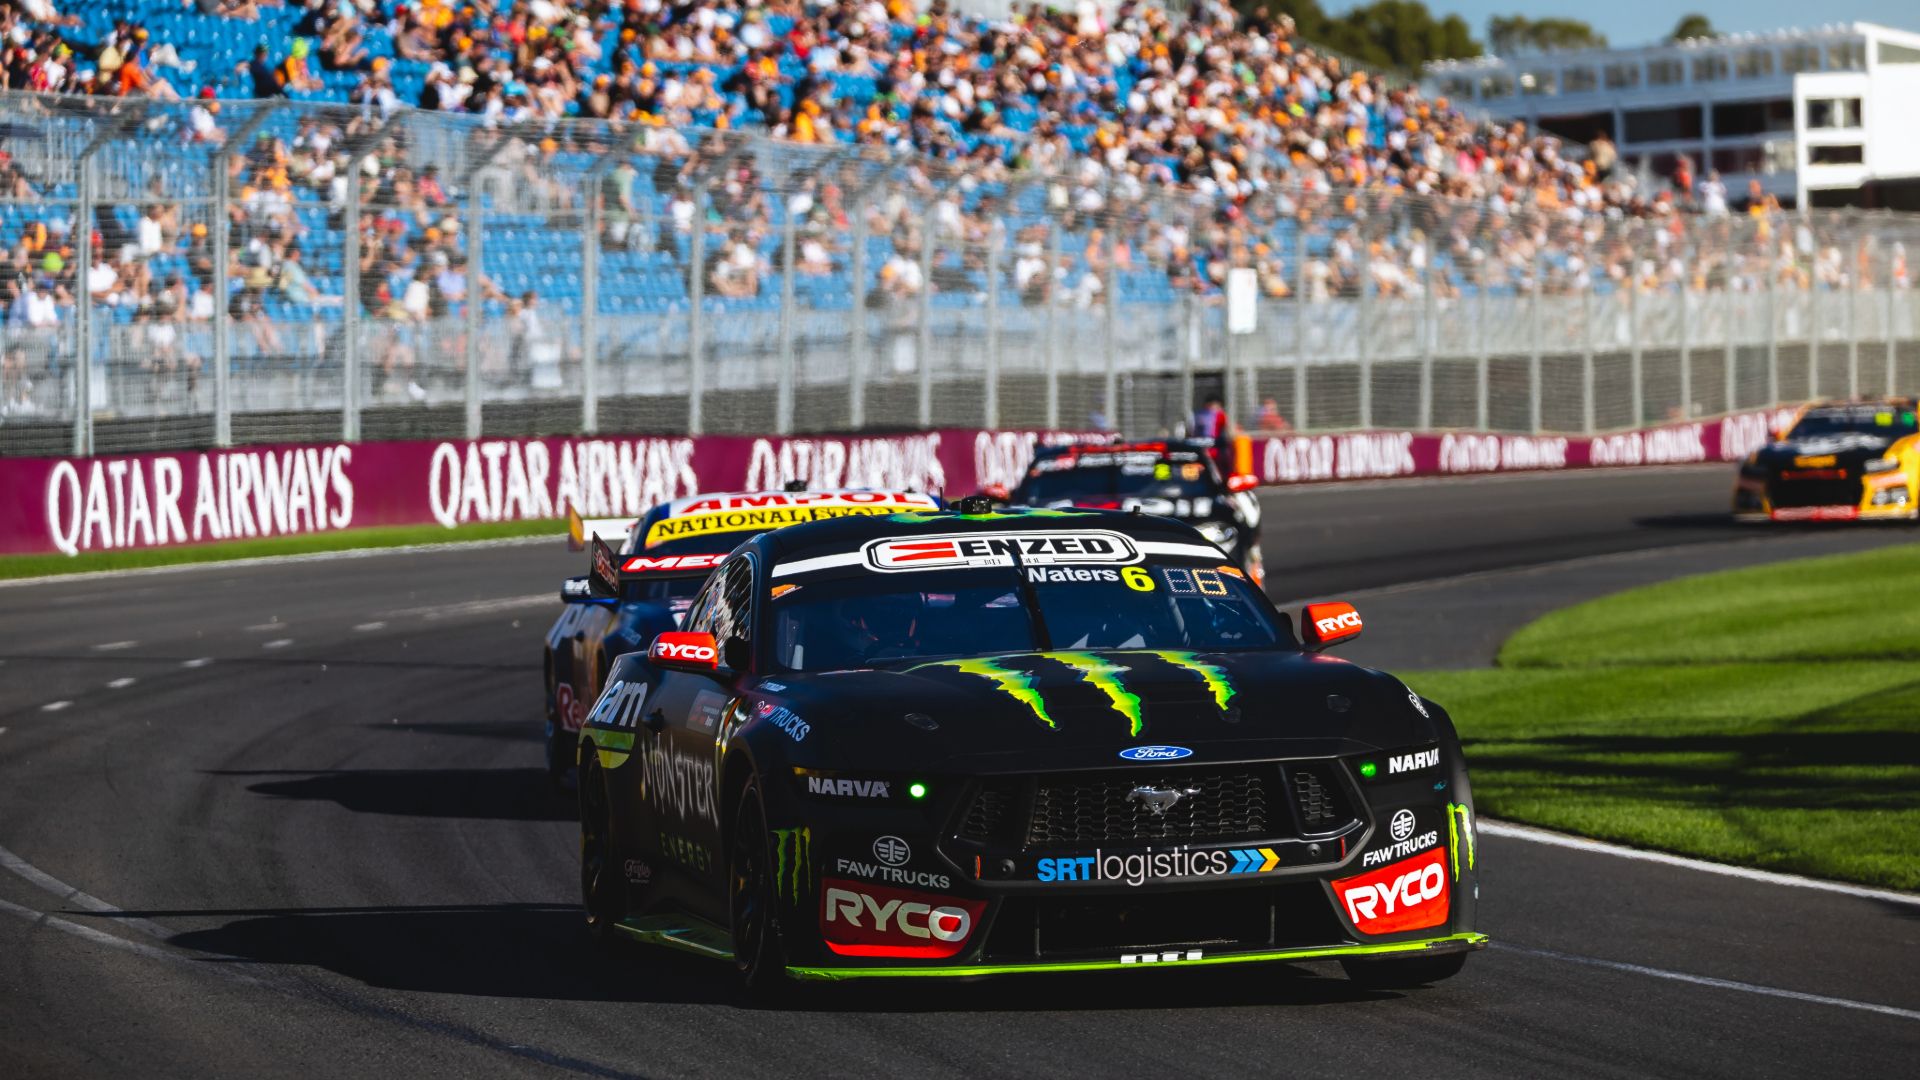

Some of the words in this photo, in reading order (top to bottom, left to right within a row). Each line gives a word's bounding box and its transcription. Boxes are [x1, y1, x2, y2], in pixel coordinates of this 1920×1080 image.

[429, 441, 552, 529] QATAR
[556, 438, 699, 519] AIRWAYS
[48, 460, 187, 556] QATAR
[194, 445, 354, 537] AIRWAYS
[682, 492, 929, 514] AMPOL
[657, 509, 807, 537] NATIONAL
[960, 538, 1115, 557] ENZED
[1121, 566, 1155, 592] 6
[655, 642, 715, 660] RYCO
[1134, 747, 1178, 759] Ford
[641, 733, 720, 830] MONSTER
[808, 776, 890, 798] NARVA
[1363, 846, 1394, 868] FAW
[1394, 830, 1438, 858] TRUCKS
[837, 858, 882, 879] FAW
[880, 864, 950, 889] TRUCKS
[1345, 861, 1445, 924] RYCO
[826, 887, 971, 942] RYCO
